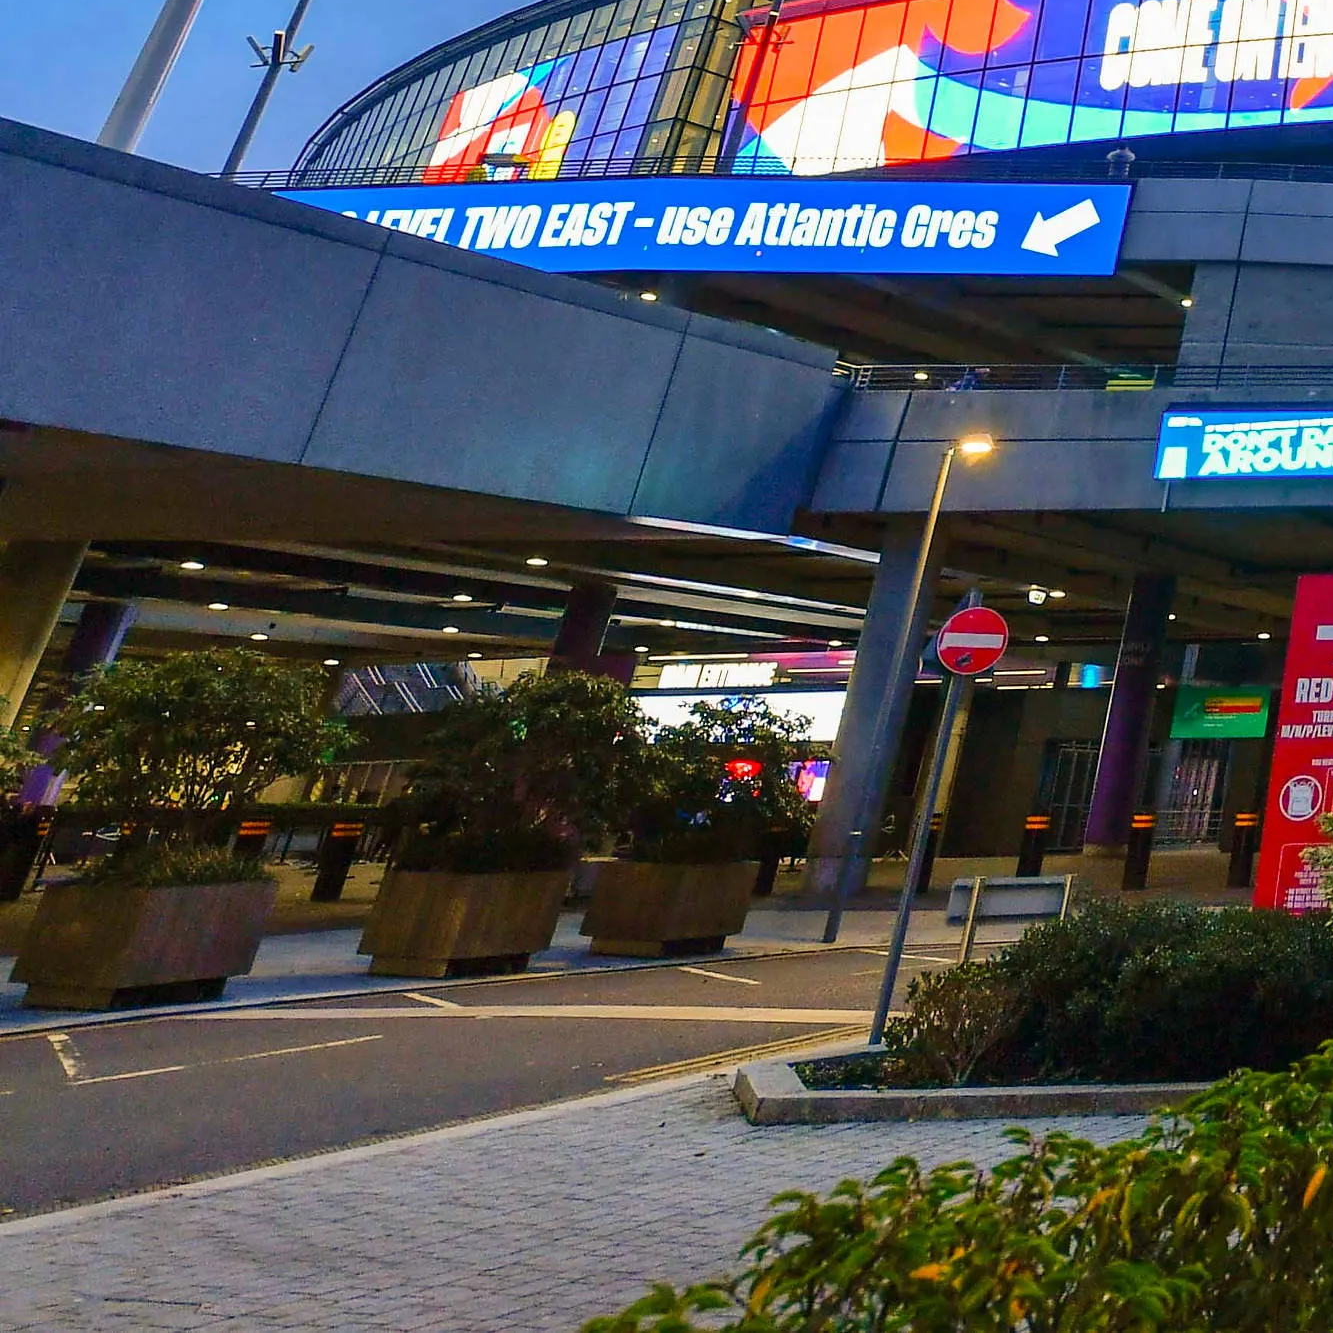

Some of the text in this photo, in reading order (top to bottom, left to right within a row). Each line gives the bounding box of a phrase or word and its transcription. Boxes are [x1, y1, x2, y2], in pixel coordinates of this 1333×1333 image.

[458, 205, 542, 250] TWO
[538, 201, 635, 248] EAST
[655, 205, 735, 246] use
[734, 202, 897, 248] Atlantic
[900, 204, 999, 249] Cres
